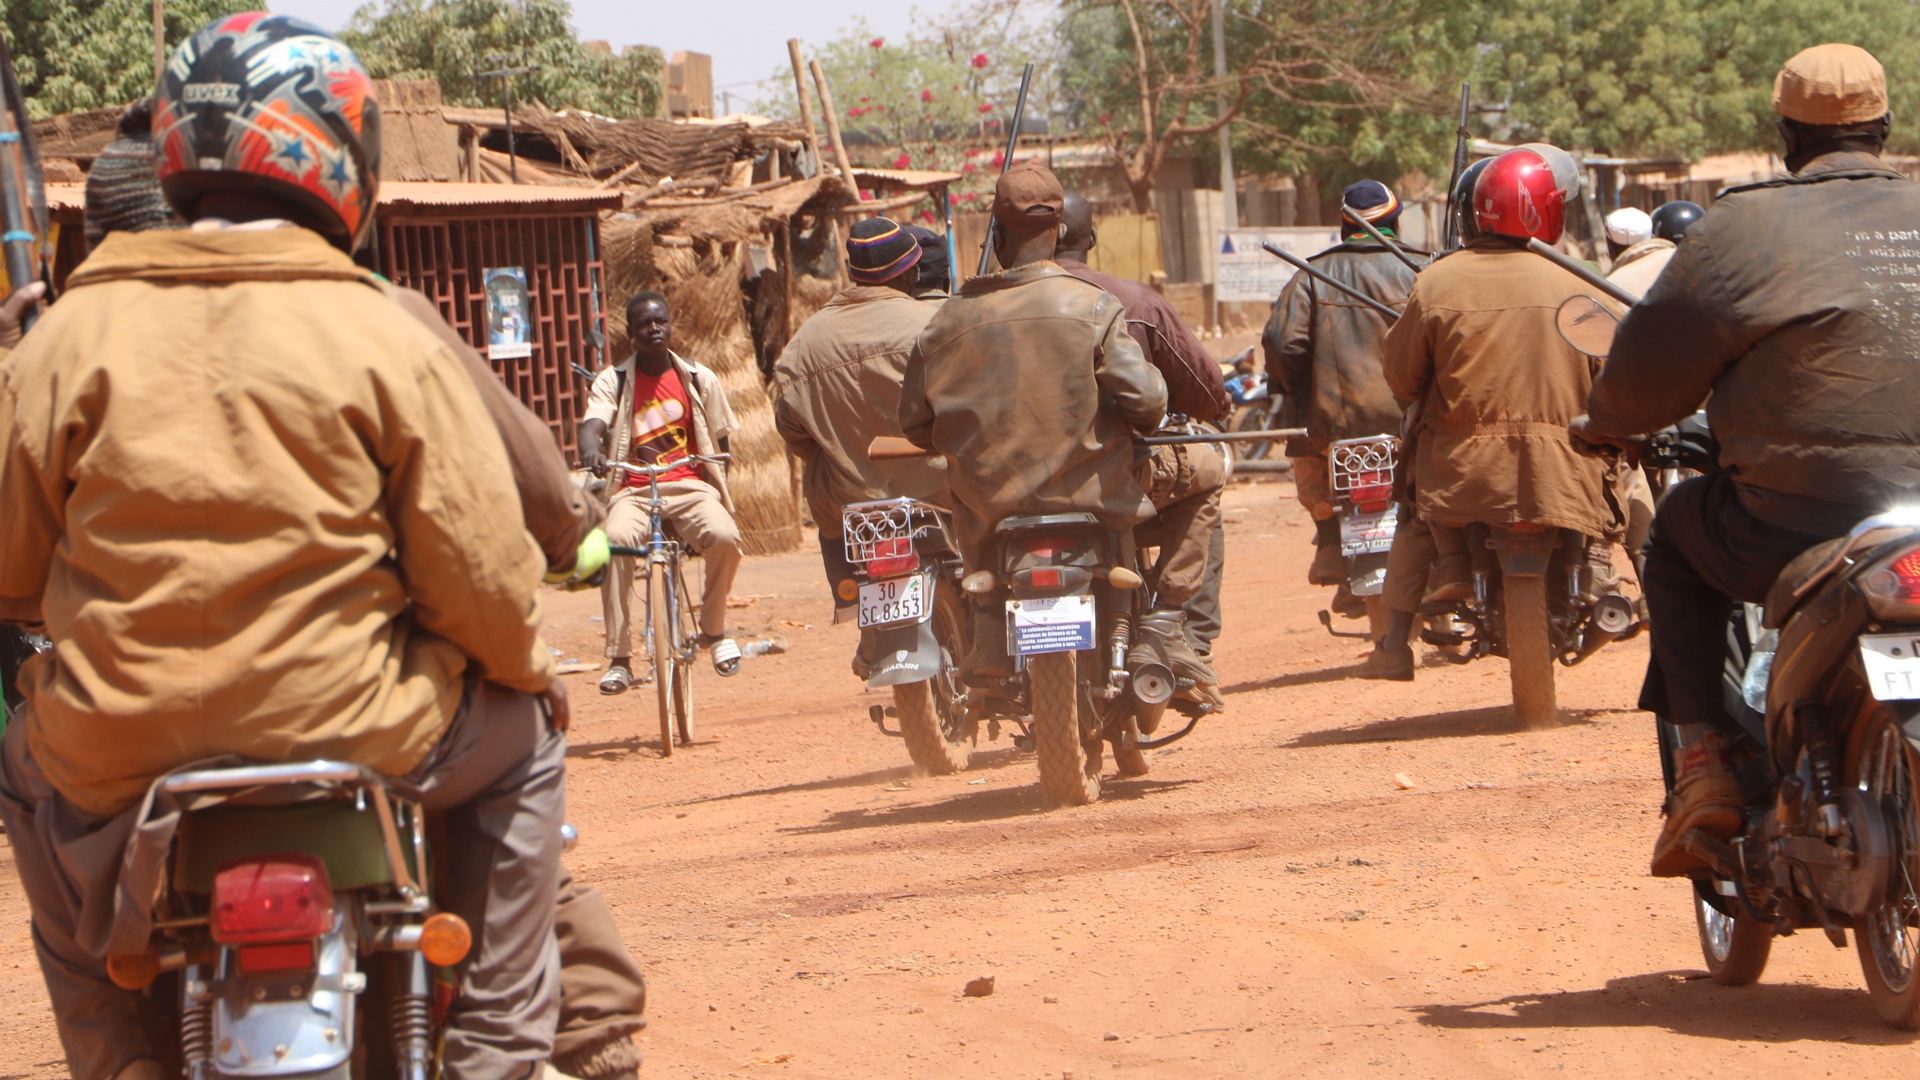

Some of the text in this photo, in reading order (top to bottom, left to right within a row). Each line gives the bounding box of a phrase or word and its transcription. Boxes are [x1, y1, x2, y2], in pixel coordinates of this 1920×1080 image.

[879, 582, 895, 601] 30
[861, 597, 920, 625] SC 8353
